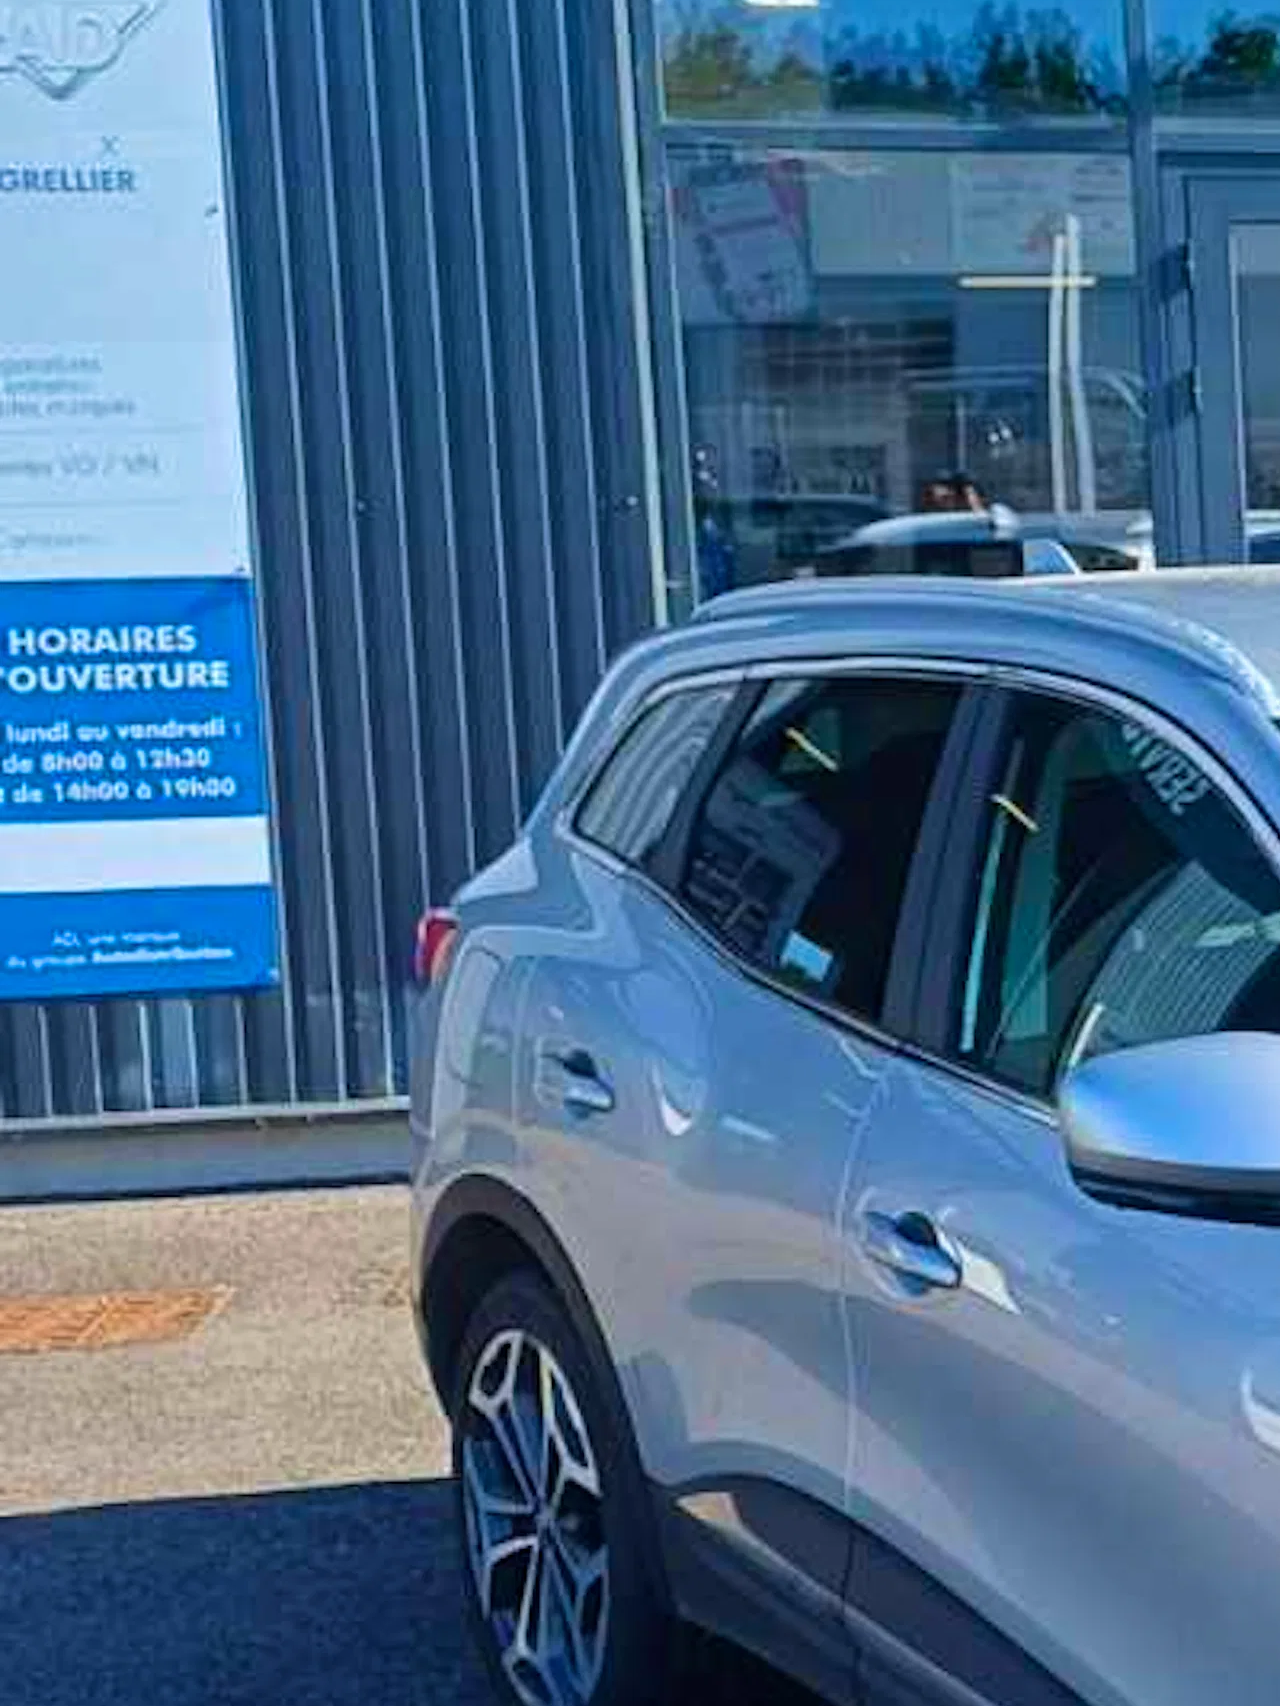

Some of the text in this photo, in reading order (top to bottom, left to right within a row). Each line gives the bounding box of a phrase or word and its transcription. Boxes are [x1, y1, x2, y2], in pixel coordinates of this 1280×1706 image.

[0, 168, 138, 193] GRELLIER
[7, 624, 198, 656] HORAIRES
[5, 720, 69, 744] lundi
[116, 716, 226, 740] vendredi
[2, 752, 34, 775] de
